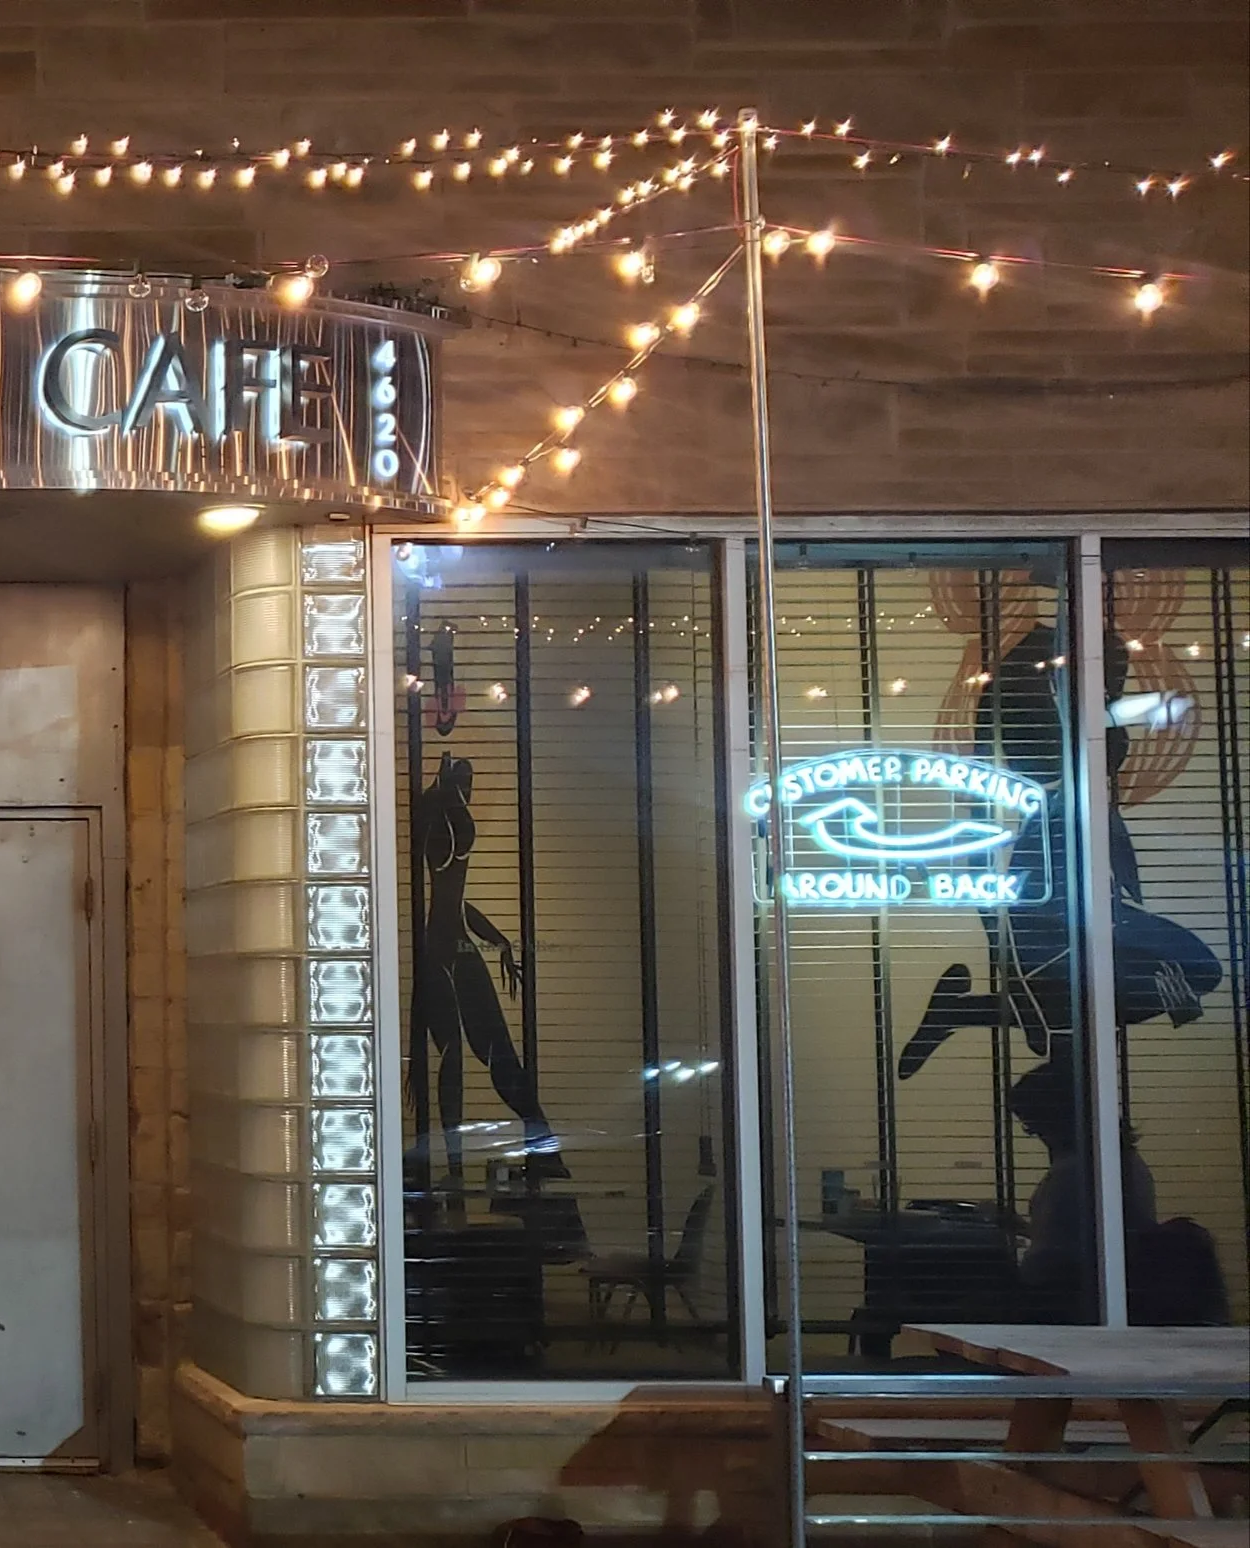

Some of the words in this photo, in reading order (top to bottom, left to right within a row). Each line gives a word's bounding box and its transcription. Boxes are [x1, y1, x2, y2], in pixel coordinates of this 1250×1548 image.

[39, 328, 333, 446] CAFE
[371, 340, 401, 478] 4620
[910, 759, 1042, 815] PARKING
[932, 873, 1020, 900] BACK
